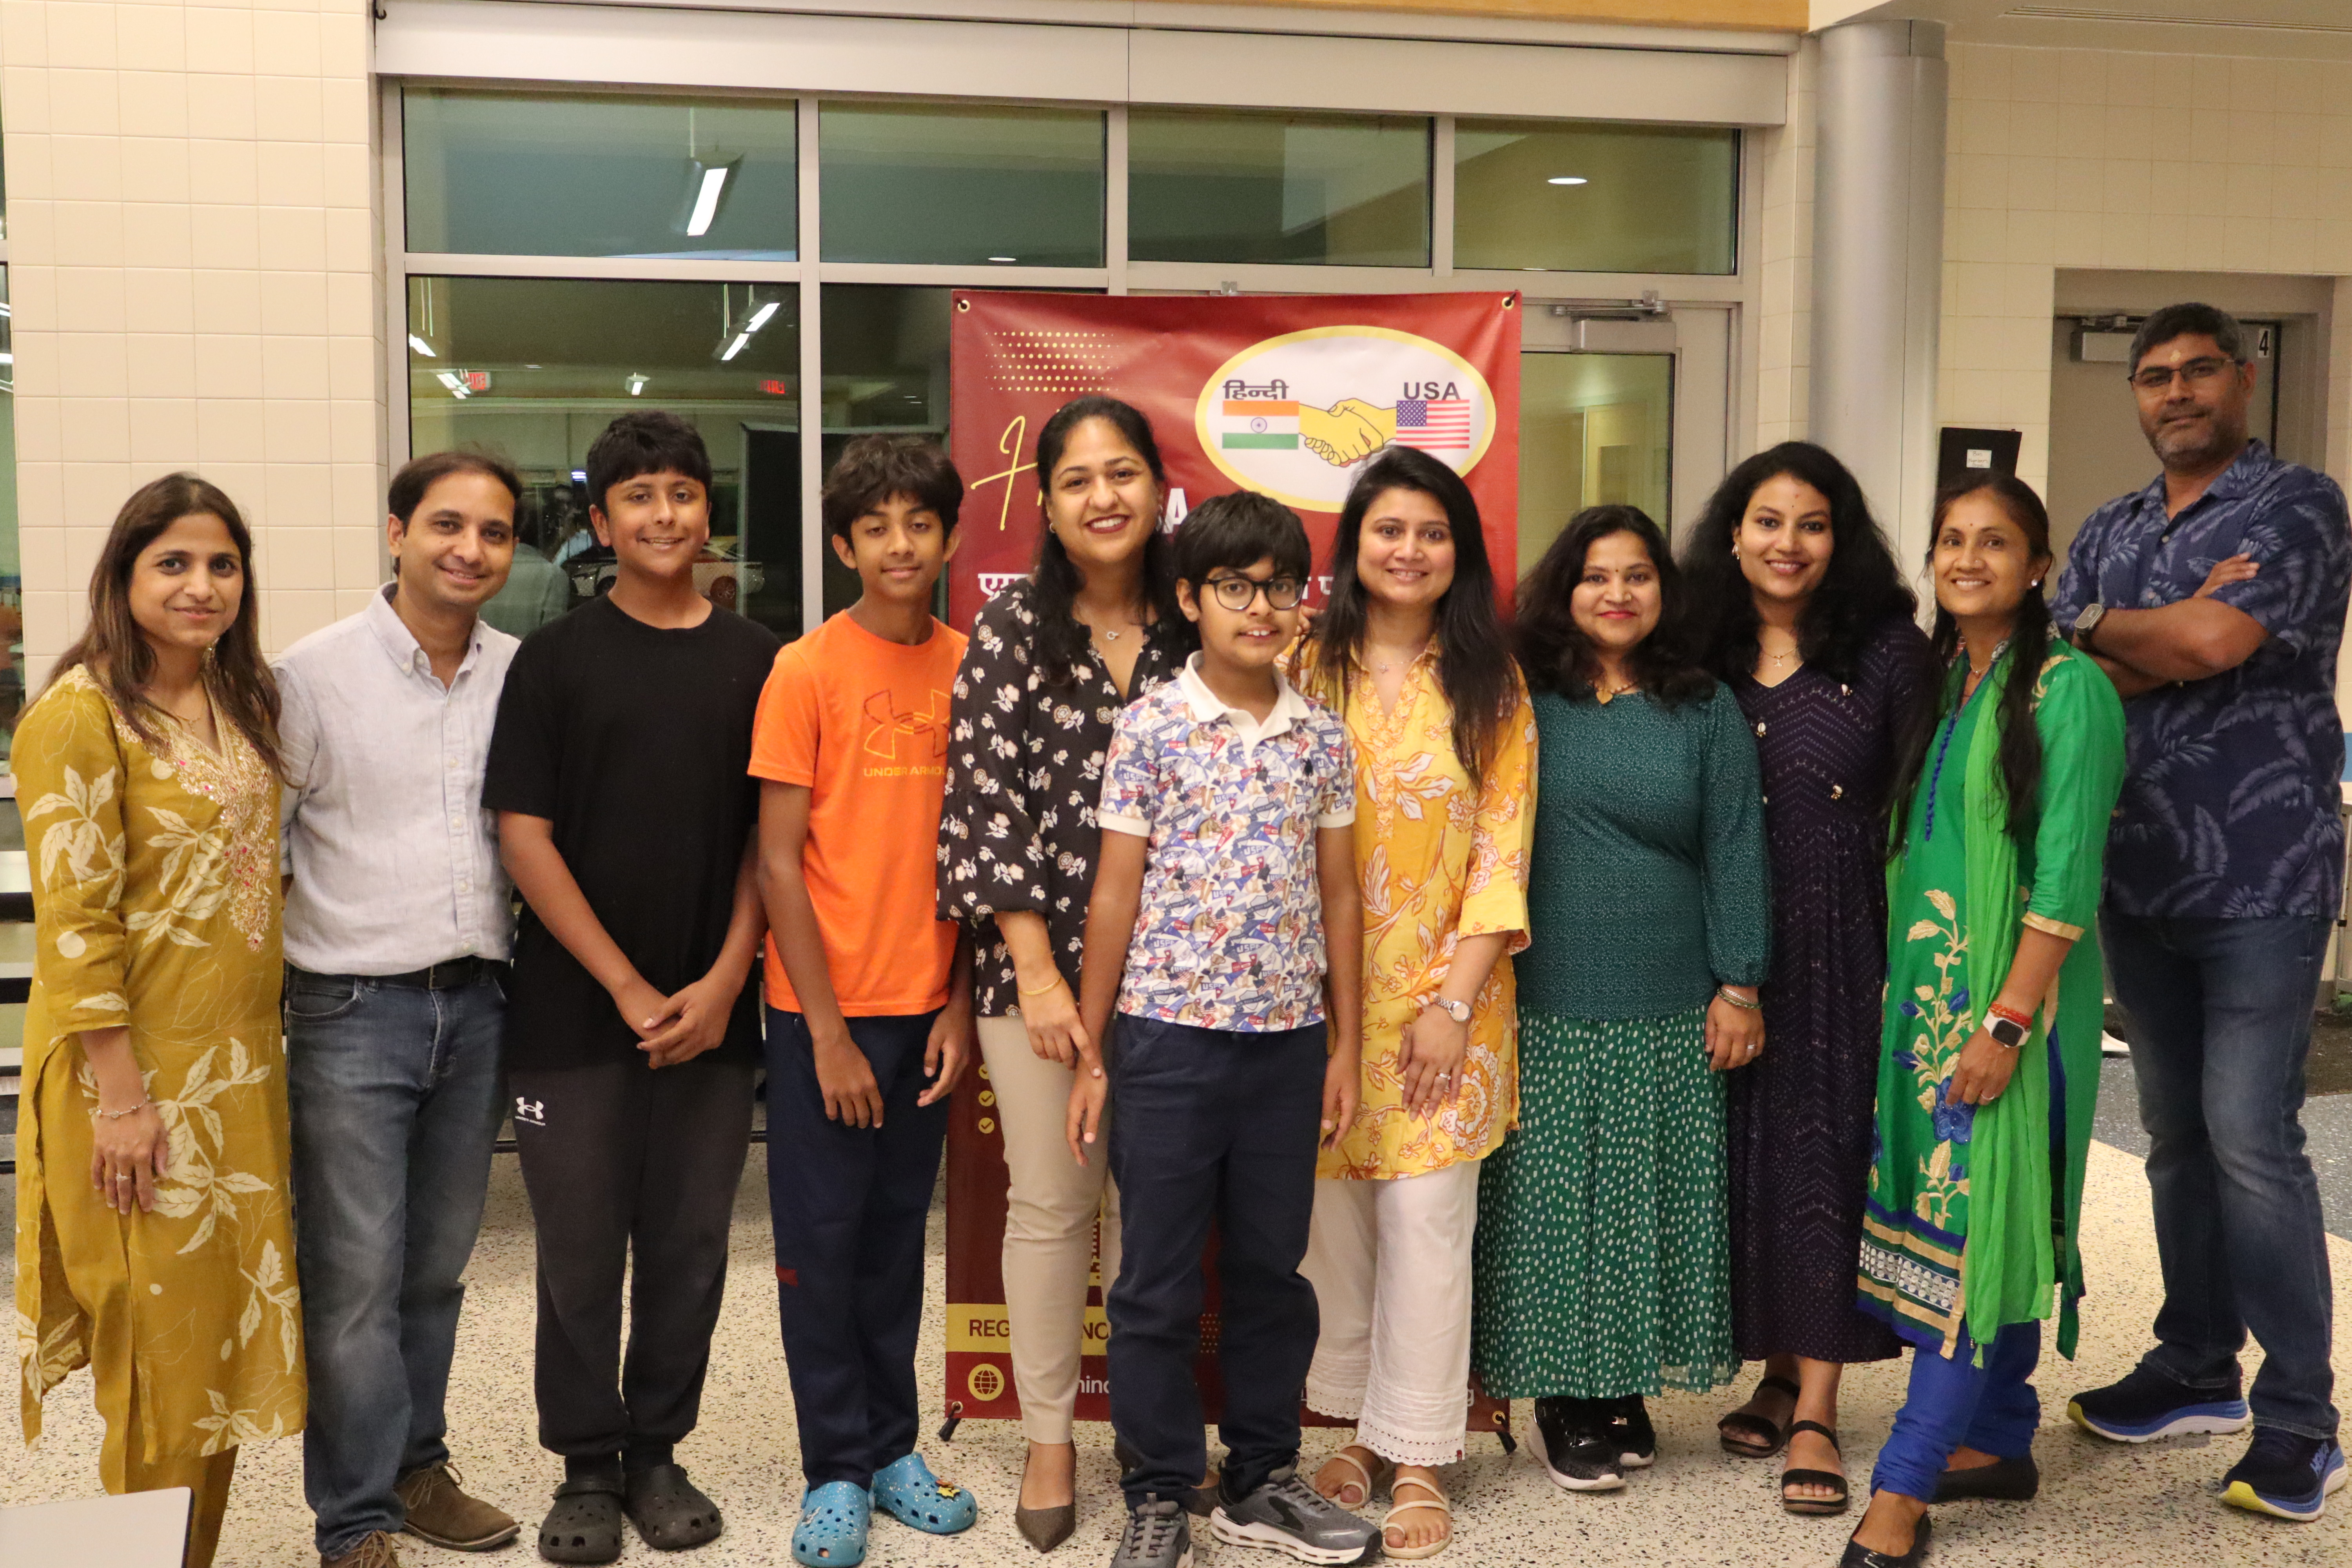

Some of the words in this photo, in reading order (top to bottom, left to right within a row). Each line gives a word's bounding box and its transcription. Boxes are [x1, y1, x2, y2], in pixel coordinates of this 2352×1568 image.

[2259, 330, 2269, 356] 4
[1223, 379, 1289, 400] हिन्दी
[1404, 382, 1461, 400] USA
[864, 767, 908, 777] UNDER
